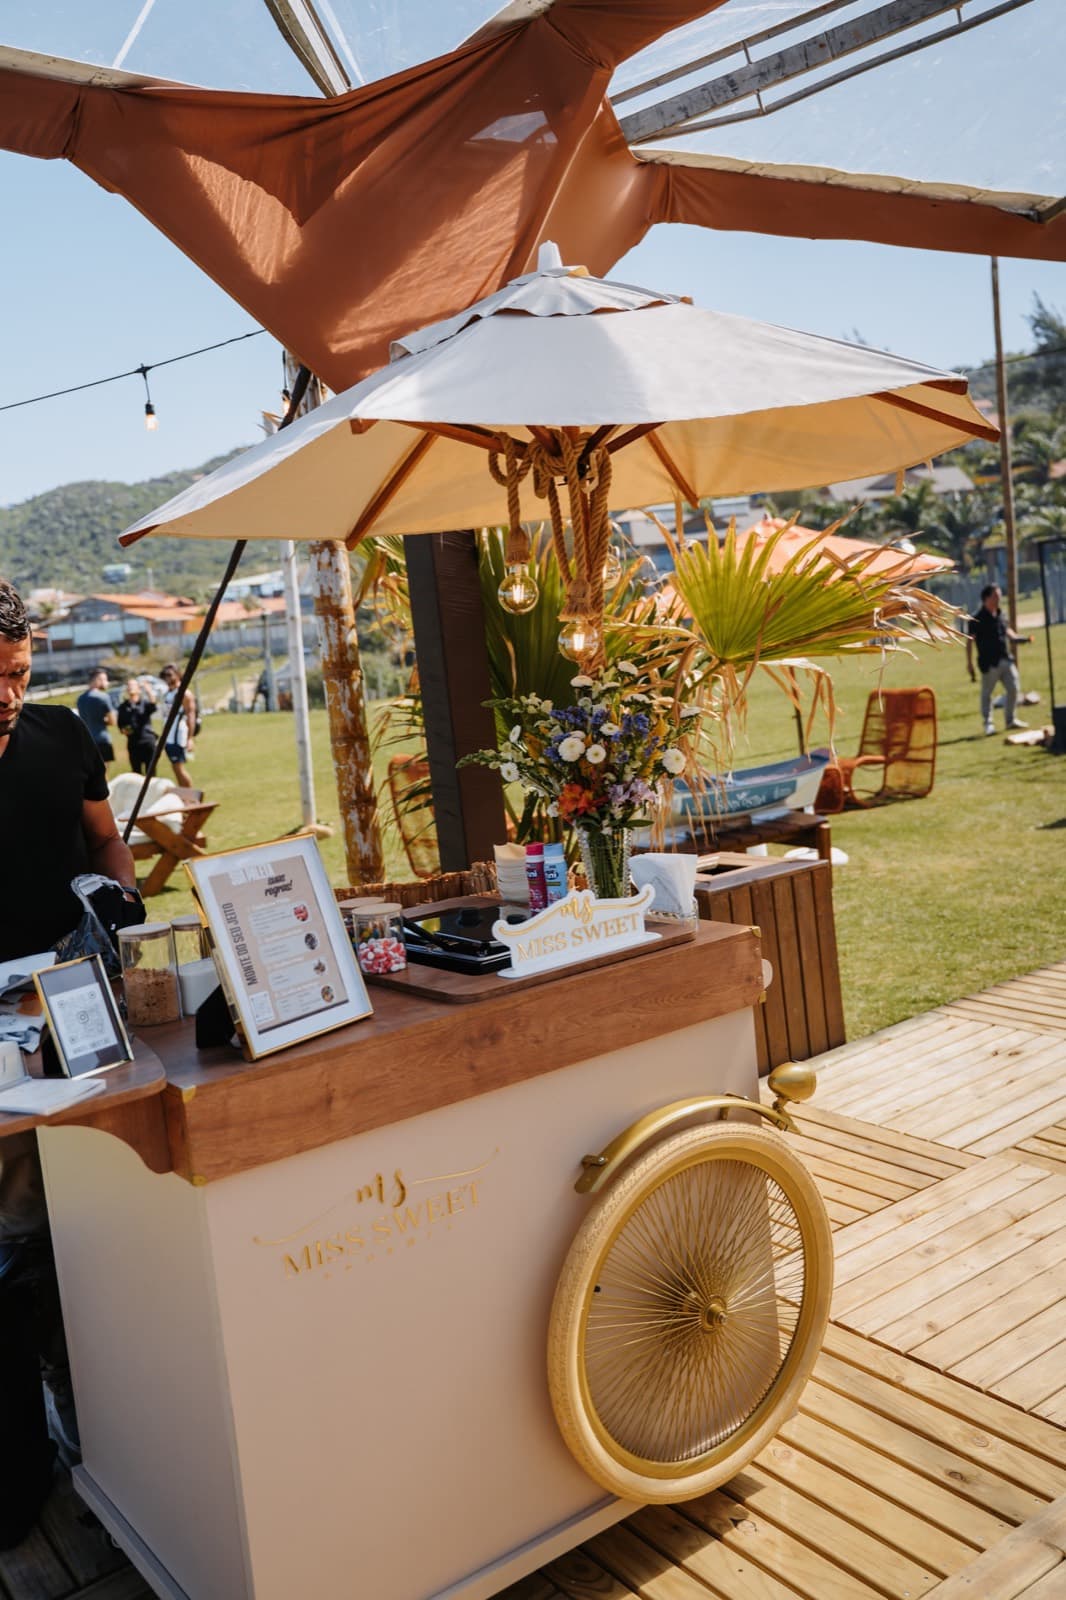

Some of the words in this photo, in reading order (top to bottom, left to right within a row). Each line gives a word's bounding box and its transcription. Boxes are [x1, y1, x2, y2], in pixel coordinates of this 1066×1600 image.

[222, 902, 239, 925] JEITO
[229, 926, 245, 944] SEU
[516, 931, 569, 963] MISS
[571, 912, 641, 948] SWEET
[235, 943, 249, 957] DO
[239, 956, 258, 986] MONTE
[282, 1225, 364, 1280] MISS
[371, 1179, 483, 1243] SWEET
